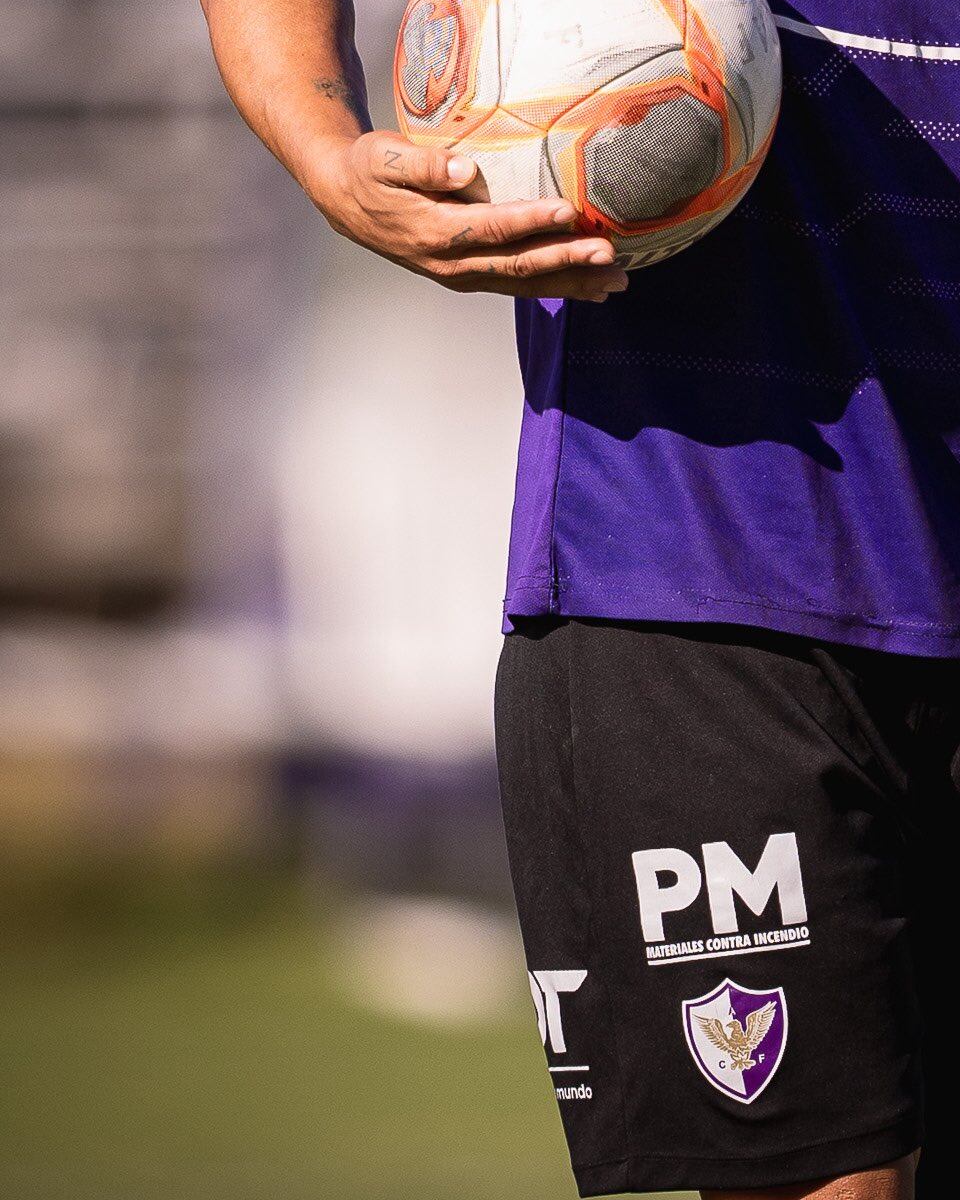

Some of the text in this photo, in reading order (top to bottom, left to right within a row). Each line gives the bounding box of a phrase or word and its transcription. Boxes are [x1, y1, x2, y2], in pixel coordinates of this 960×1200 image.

[631, 832, 808, 943] PM
[646, 926, 810, 959] MATERIALES CONTRA INCENDIO
[718, 1053, 766, 1070] C F
